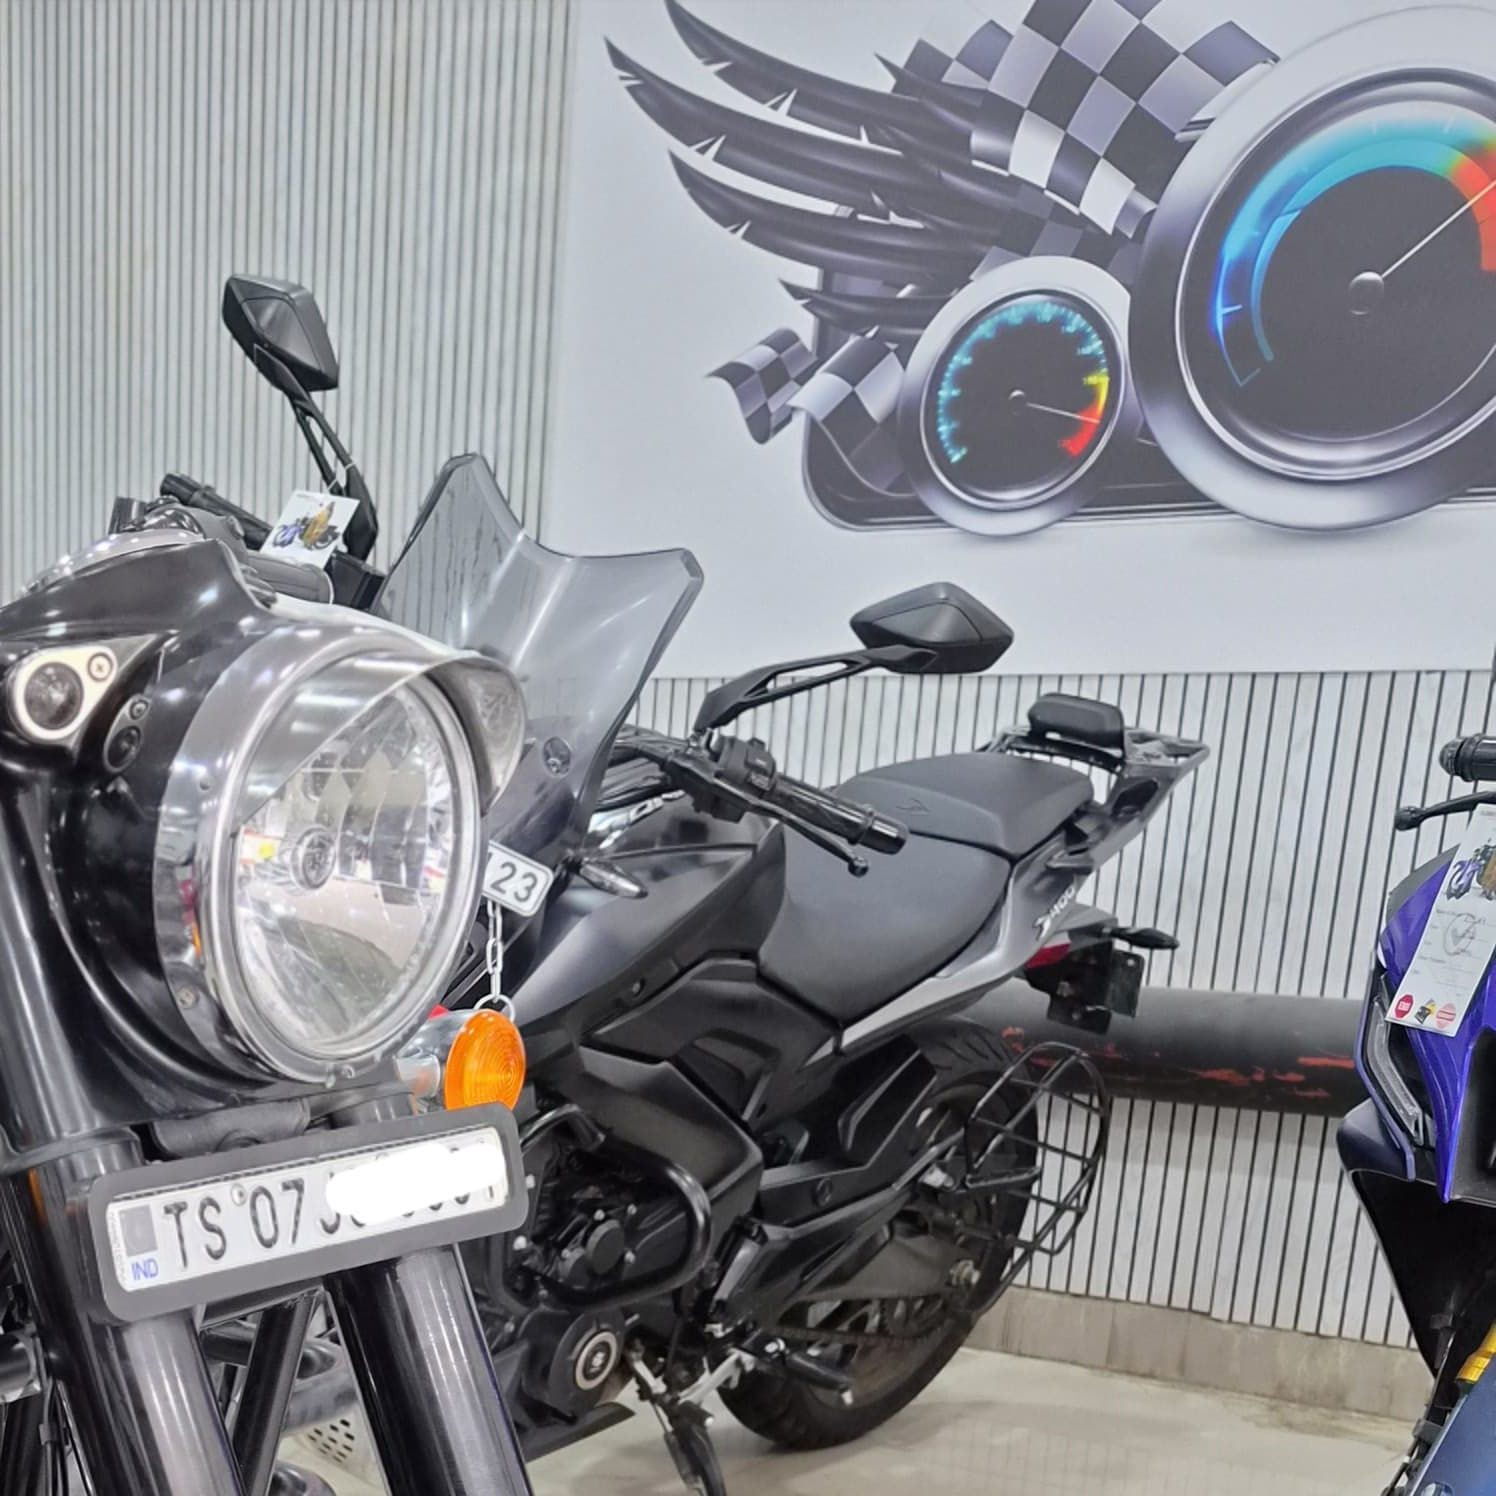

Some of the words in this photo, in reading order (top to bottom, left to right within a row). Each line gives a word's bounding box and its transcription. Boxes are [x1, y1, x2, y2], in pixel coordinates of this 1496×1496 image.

[164, 1197, 227, 1268] TS
[249, 1179, 305, 1249] 07
[131, 1258, 159, 1281] IND
